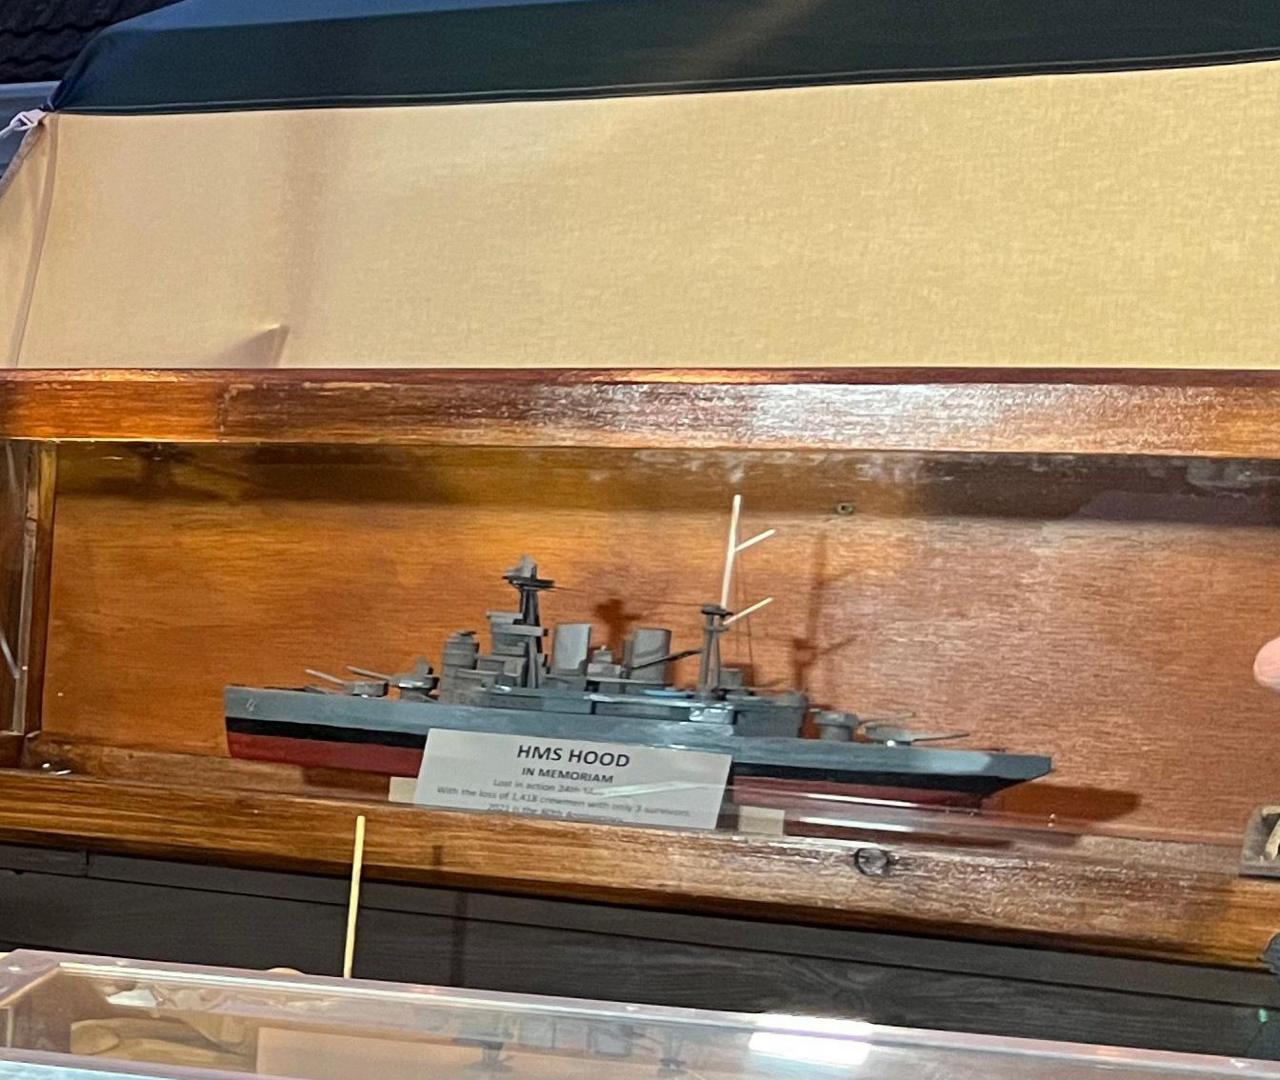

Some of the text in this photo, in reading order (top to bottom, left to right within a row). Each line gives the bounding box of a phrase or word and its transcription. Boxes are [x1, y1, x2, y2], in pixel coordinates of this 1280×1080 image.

[517, 745, 630, 767] HMS HOOD
[522, 768, 614, 783] IN MEMORIAM
